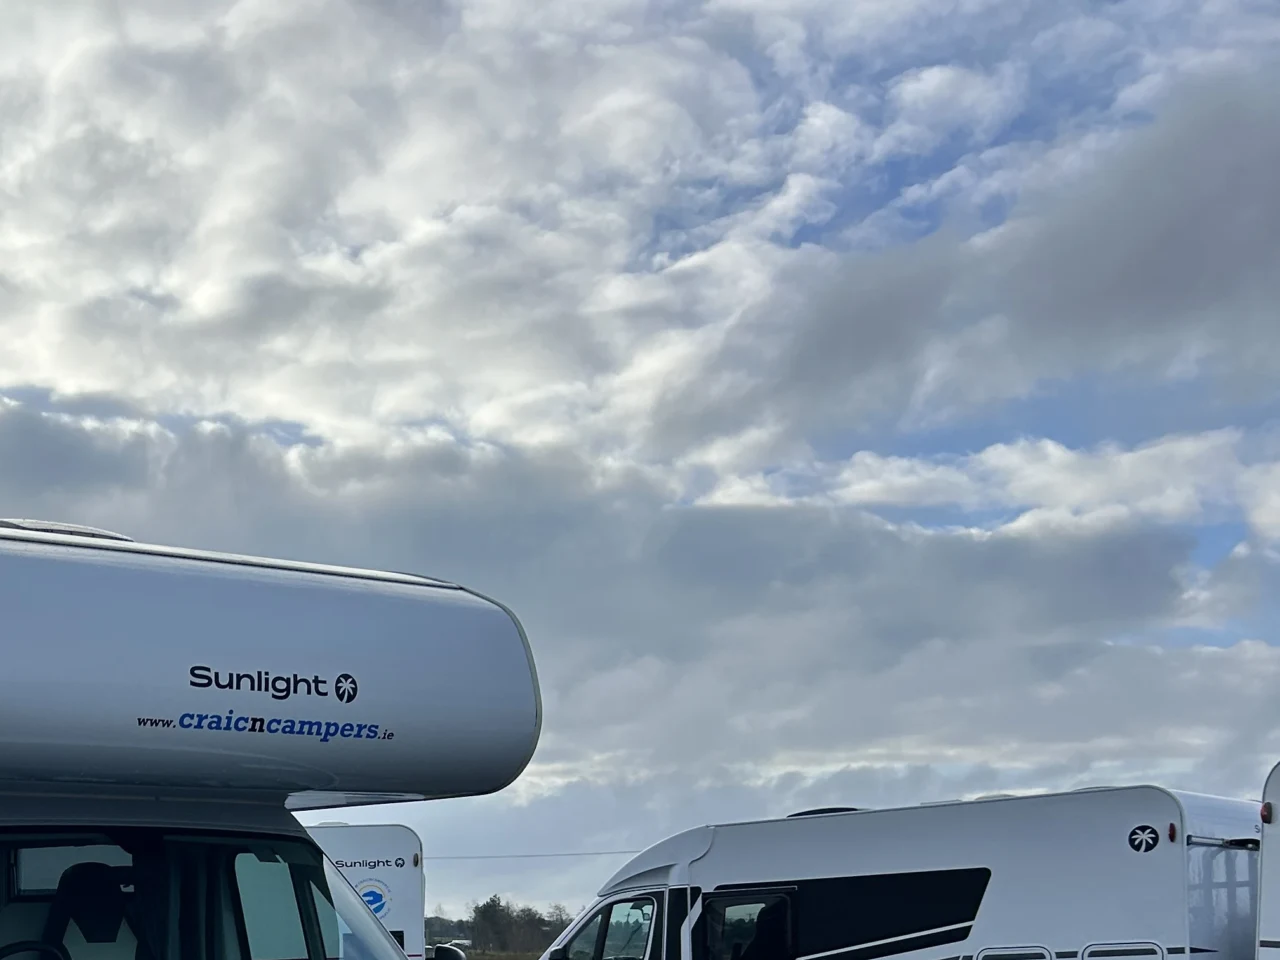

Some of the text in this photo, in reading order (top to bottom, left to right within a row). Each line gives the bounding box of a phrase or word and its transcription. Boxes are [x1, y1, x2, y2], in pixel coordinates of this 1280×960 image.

[189, 665, 329, 701] Sunlight
[136, 709, 395, 743] www.craicncampers.ie
[335, 859, 393, 870] Sunlight
